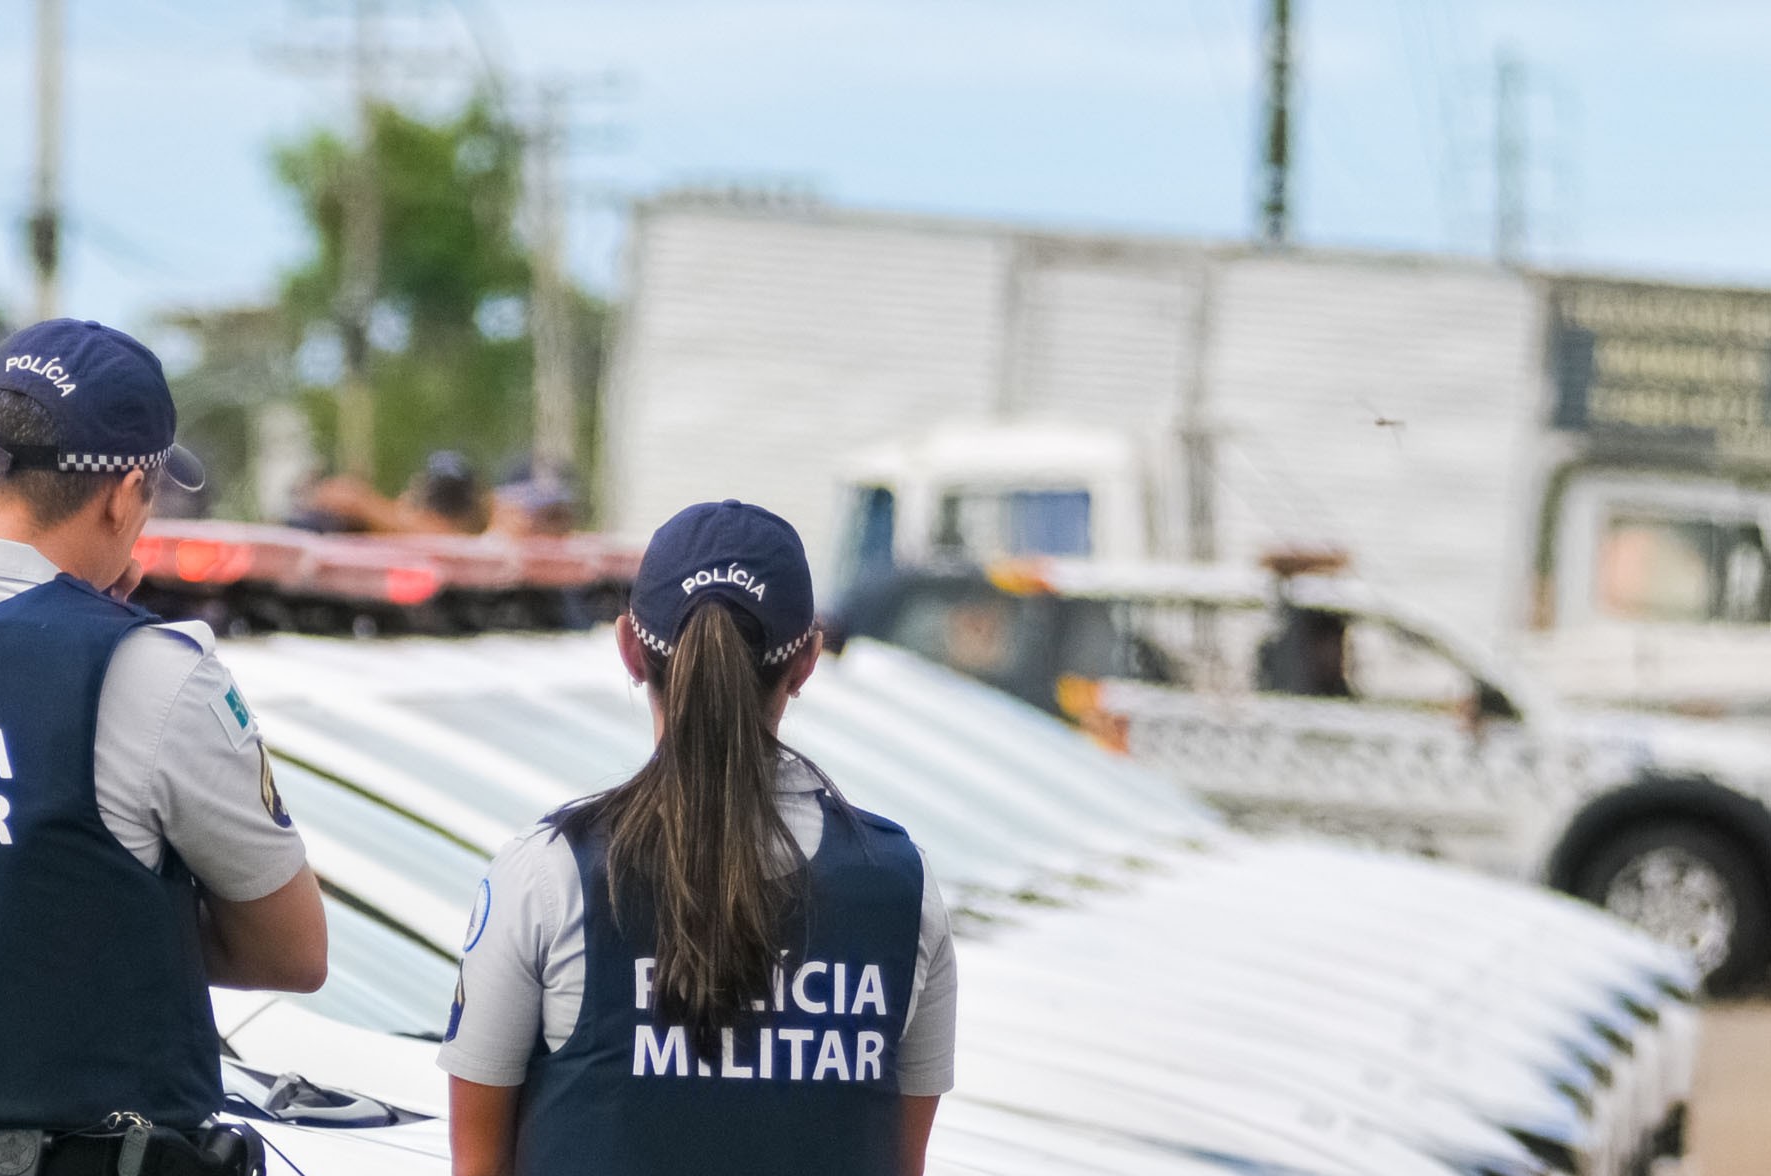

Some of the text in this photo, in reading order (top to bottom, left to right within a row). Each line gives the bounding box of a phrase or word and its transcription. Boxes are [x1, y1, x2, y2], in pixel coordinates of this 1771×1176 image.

[5, 354, 77, 398] POLÍCIA
[681, 562, 766, 602] POLÍCIA
[632, 1024, 885, 1081] MLITAR
